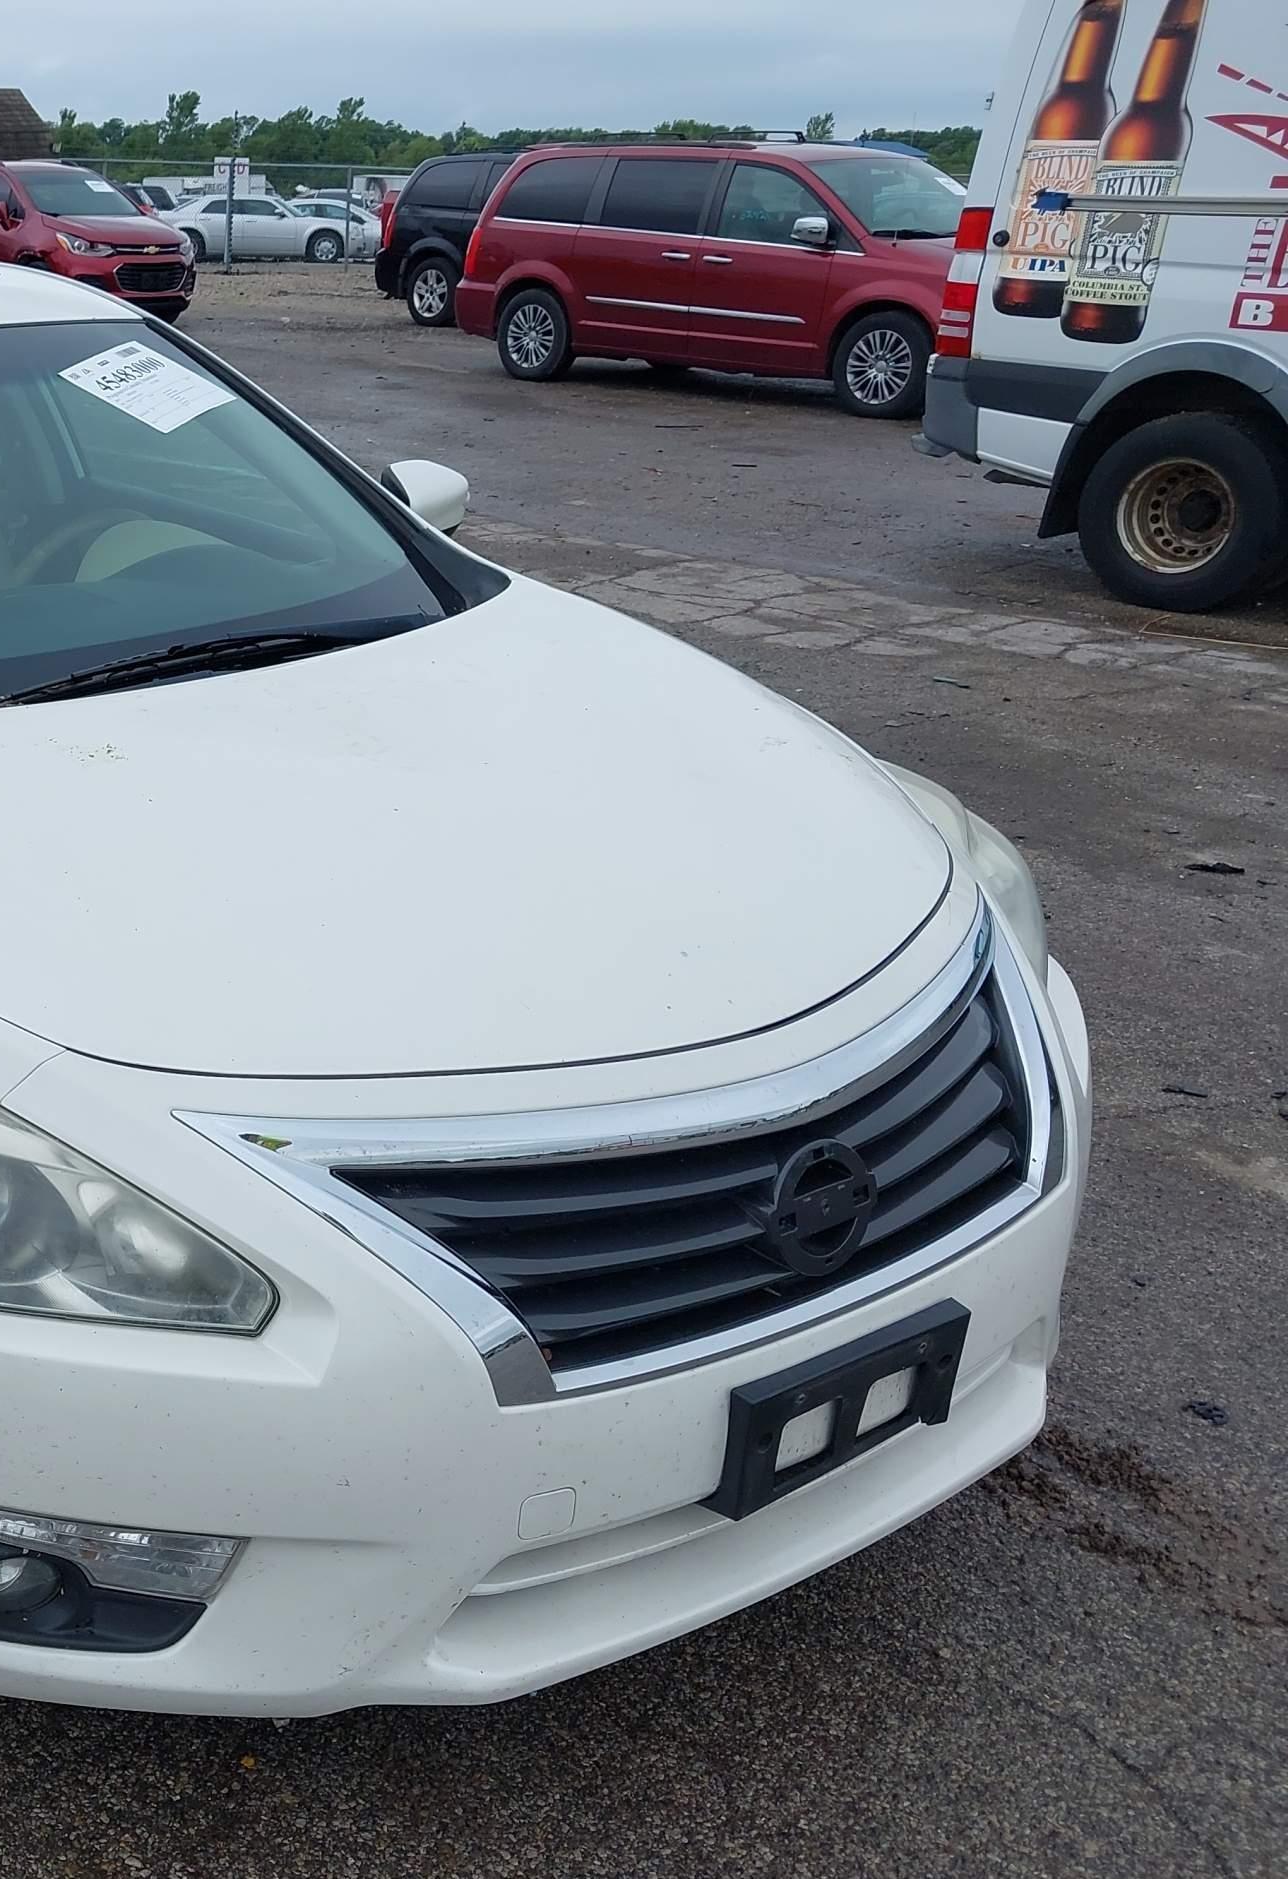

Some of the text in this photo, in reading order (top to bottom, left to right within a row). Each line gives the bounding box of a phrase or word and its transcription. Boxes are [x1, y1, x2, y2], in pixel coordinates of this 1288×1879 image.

[1032, 156, 1089, 179] BLIND
[1105, 176, 1163, 195] BLIND
[1018, 221, 1069, 249] PIG
[1087, 244, 1142, 272] PIG
[1240, 218, 1279, 287] THE
[1064, 287, 1150, 301] COFFEE STOUT
[1072, 280, 1144, 292] COLUMBIA ST.
[95, 356, 166, 391] 45483000
